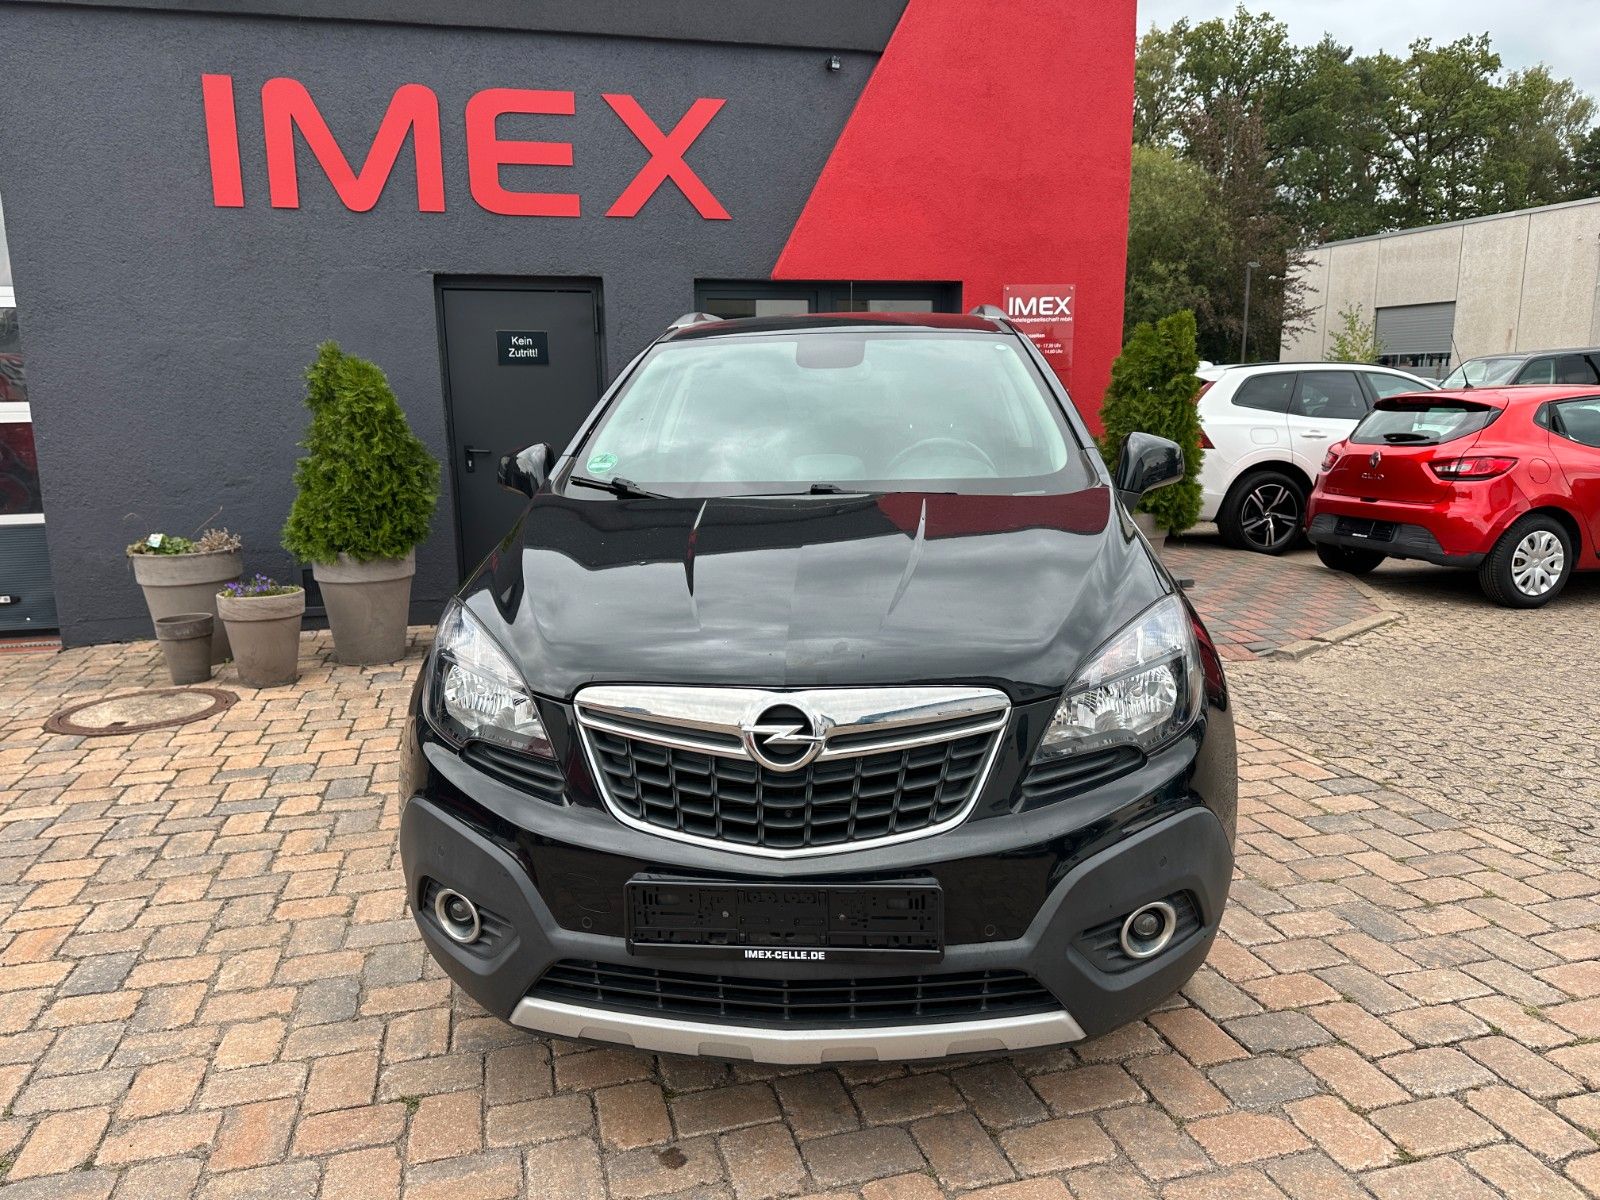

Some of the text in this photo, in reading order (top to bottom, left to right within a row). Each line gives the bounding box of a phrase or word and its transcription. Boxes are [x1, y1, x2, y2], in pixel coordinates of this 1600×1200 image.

[201, 73, 732, 220] IMEX
[1008, 296, 1071, 315] IMEX
[511, 336, 533, 345] Kein
[508, 348, 538, 357] Zutritt!
[744, 950, 825, 960] IMEX-CELLE.DE
